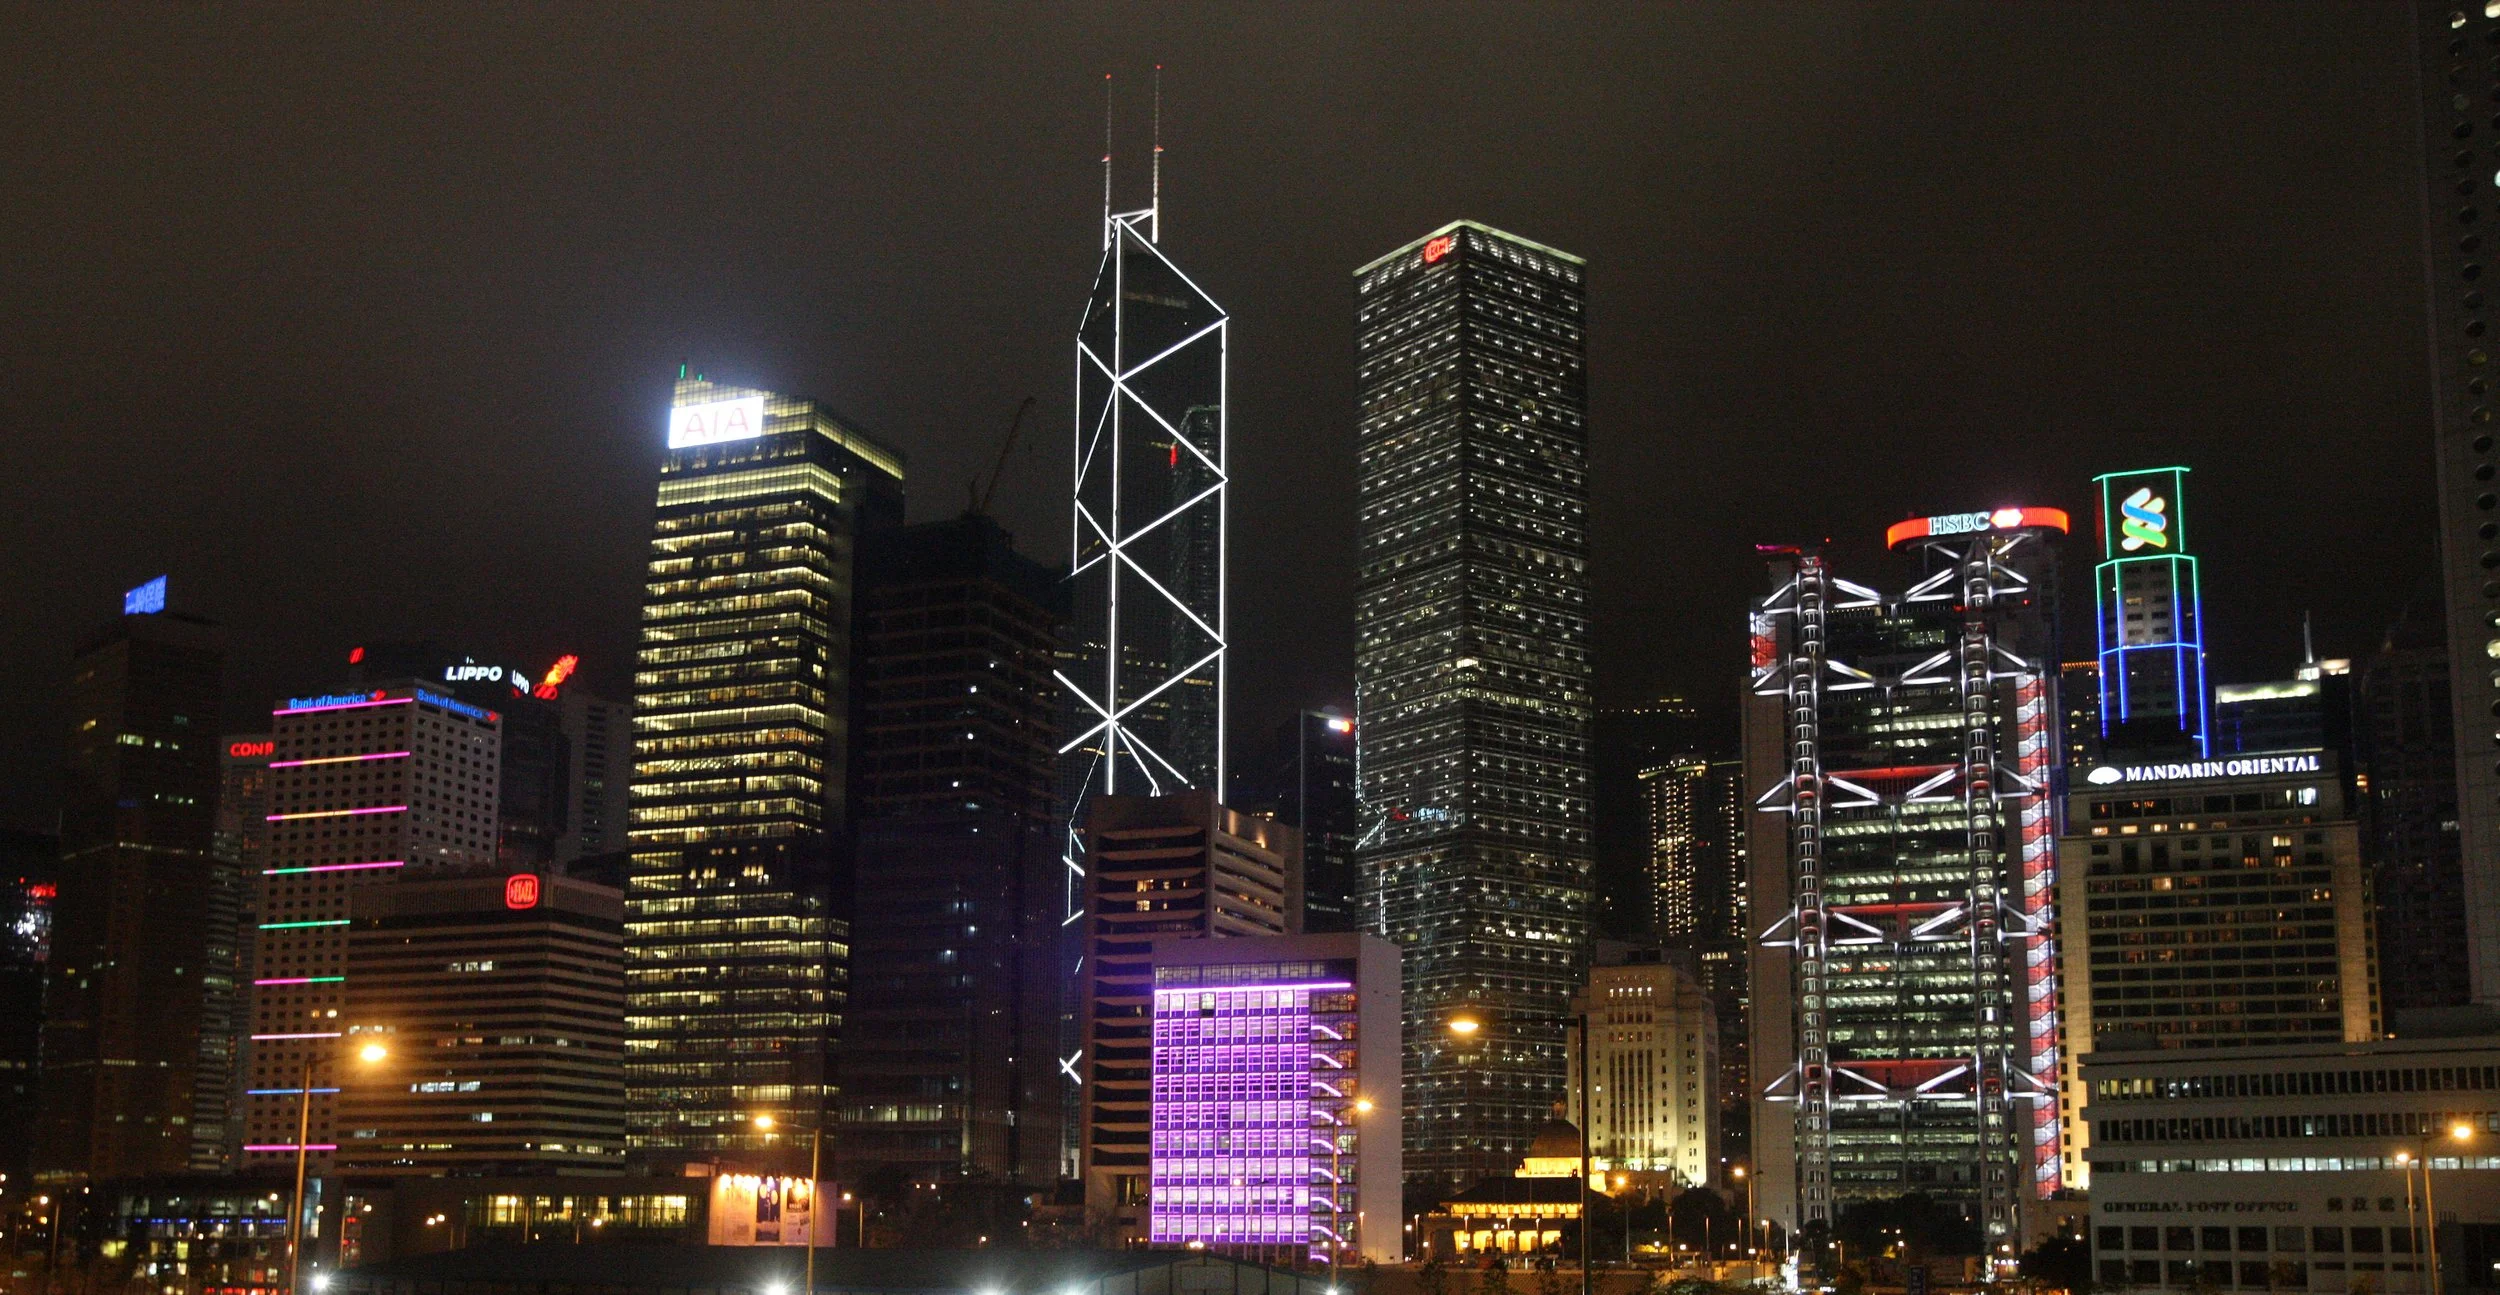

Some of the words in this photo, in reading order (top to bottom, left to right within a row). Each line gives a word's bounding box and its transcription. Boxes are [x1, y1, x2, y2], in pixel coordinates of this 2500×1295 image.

[682, 407, 749, 441] AIA
[1928, 511, 1991, 536] HSBC
[445, 665, 503, 682] LIPPO
[511, 669, 530, 695] LIPPO
[289, 697, 314, 710] Bank
[315, 695, 326, 708] of
[326, 692, 367, 707] America
[416, 688, 438, 705] Bank
[438, 694, 449, 708] of
[449, 697, 483, 719] America
[2125, 761, 2224, 782] MANDARIN
[2226, 755, 2320, 776] ORIENTAL
